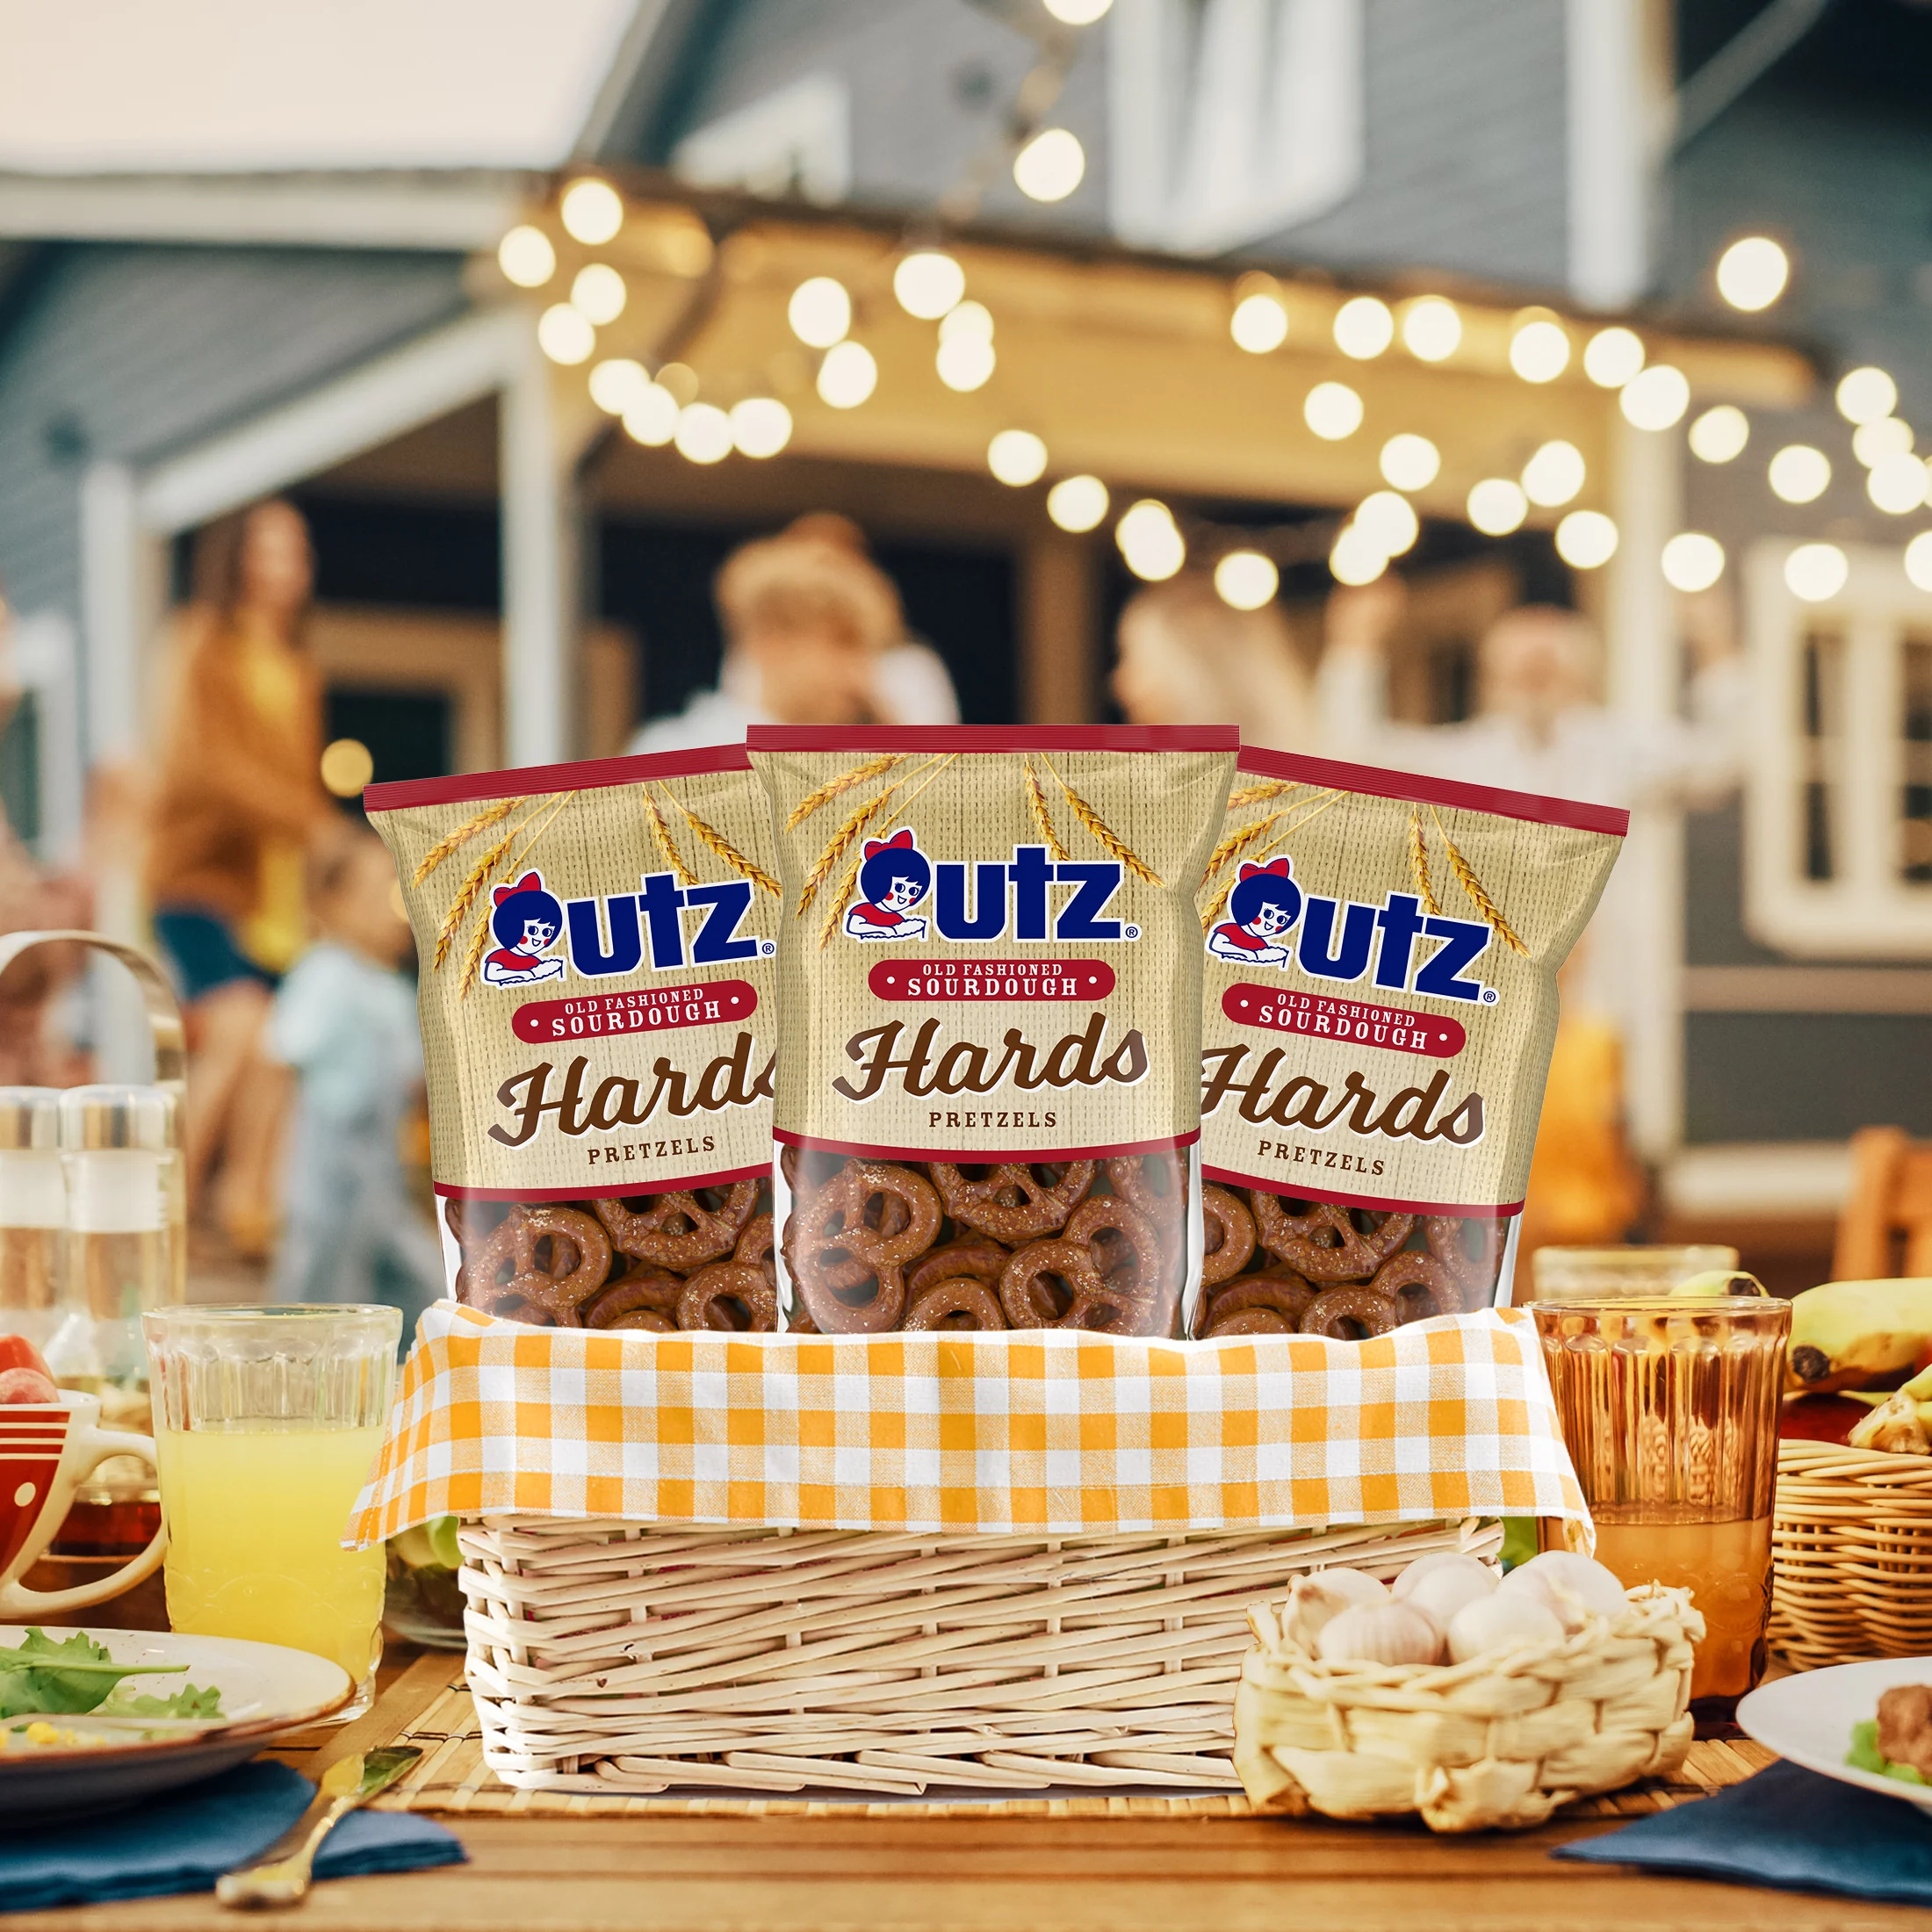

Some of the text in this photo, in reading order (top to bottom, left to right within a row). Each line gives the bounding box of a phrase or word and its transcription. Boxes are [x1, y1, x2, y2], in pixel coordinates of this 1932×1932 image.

[923, 963, 1063, 976] OLD FASHIONED
[565, 988, 704, 1014] OLD FASHIONED
[907, 978, 1078, 996] SOURDOUGH
[551, 1000, 721, 1037] SOURDOUGH
[1277, 993, 1416, 1027] OLD FASHIONED
[1258, 1006, 1428, 1049] SOURDOUGH
[832, 1012, 1148, 1104] Hards
[1201, 1043, 1485, 1143] Hards
[929, 1112, 1057, 1128] PRETZELS
[588, 1135, 716, 1165] PRETZELS
[1257, 1140, 1385, 1176] PRETZELS
